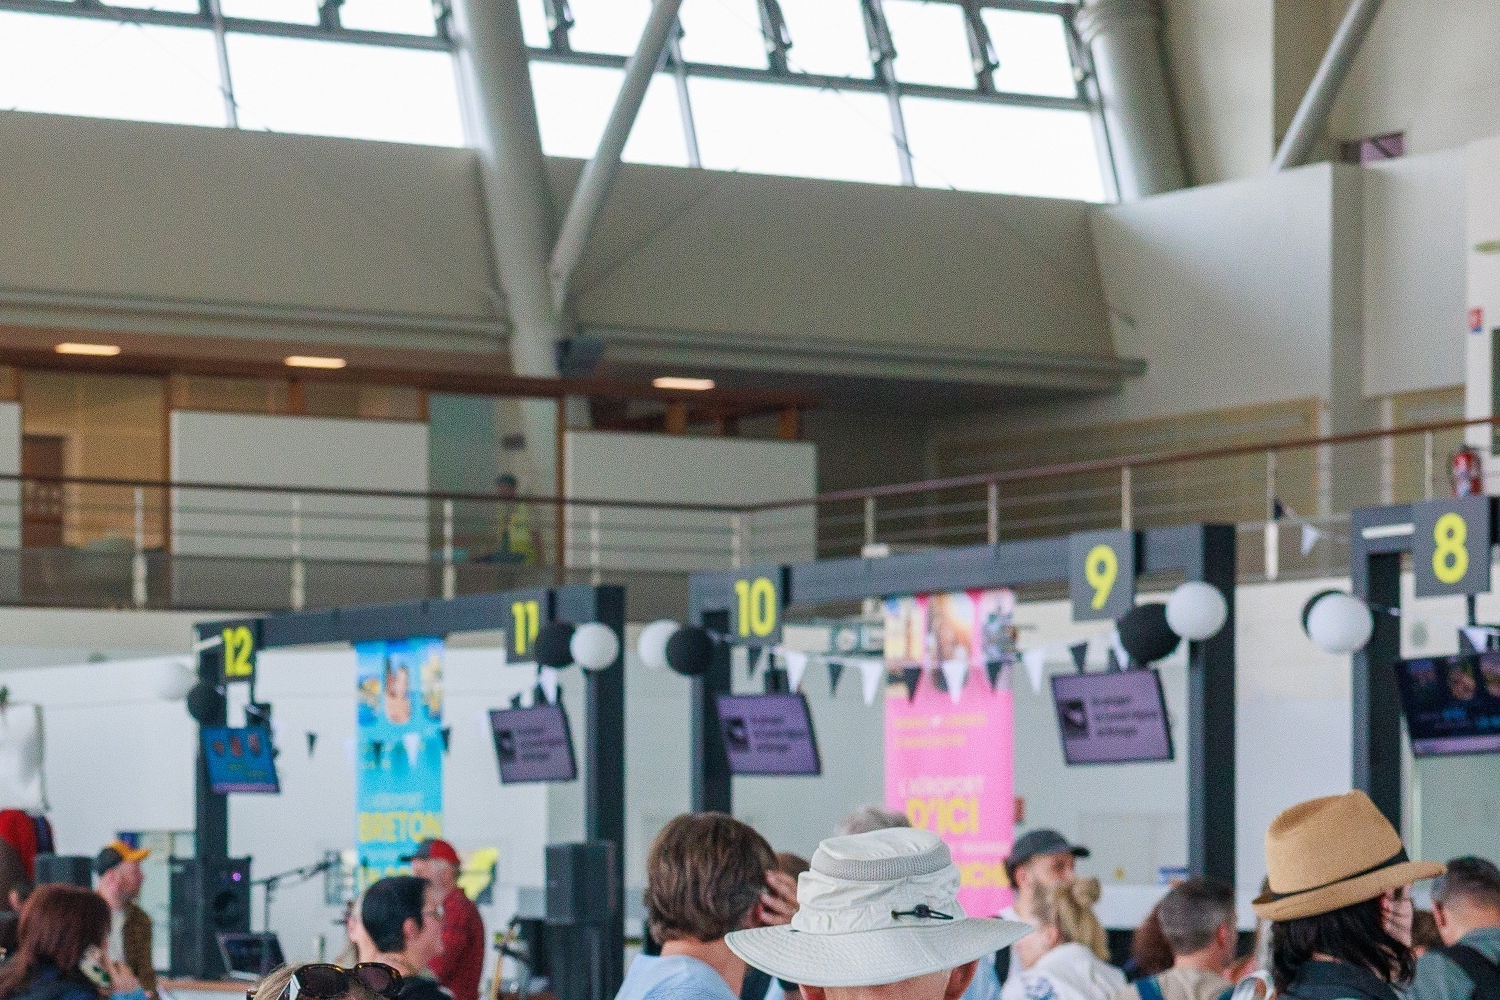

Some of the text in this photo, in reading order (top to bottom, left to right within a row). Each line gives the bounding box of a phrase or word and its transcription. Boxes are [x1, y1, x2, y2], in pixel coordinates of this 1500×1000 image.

[1432, 512, 1470, 584] 8
[1085, 544, 1119, 610] 9
[512, 601, 540, 655] 11
[735, 577, 777, 637] 10
[222, 626, 254, 677] 12
[359, 812, 443, 843] BRETON
